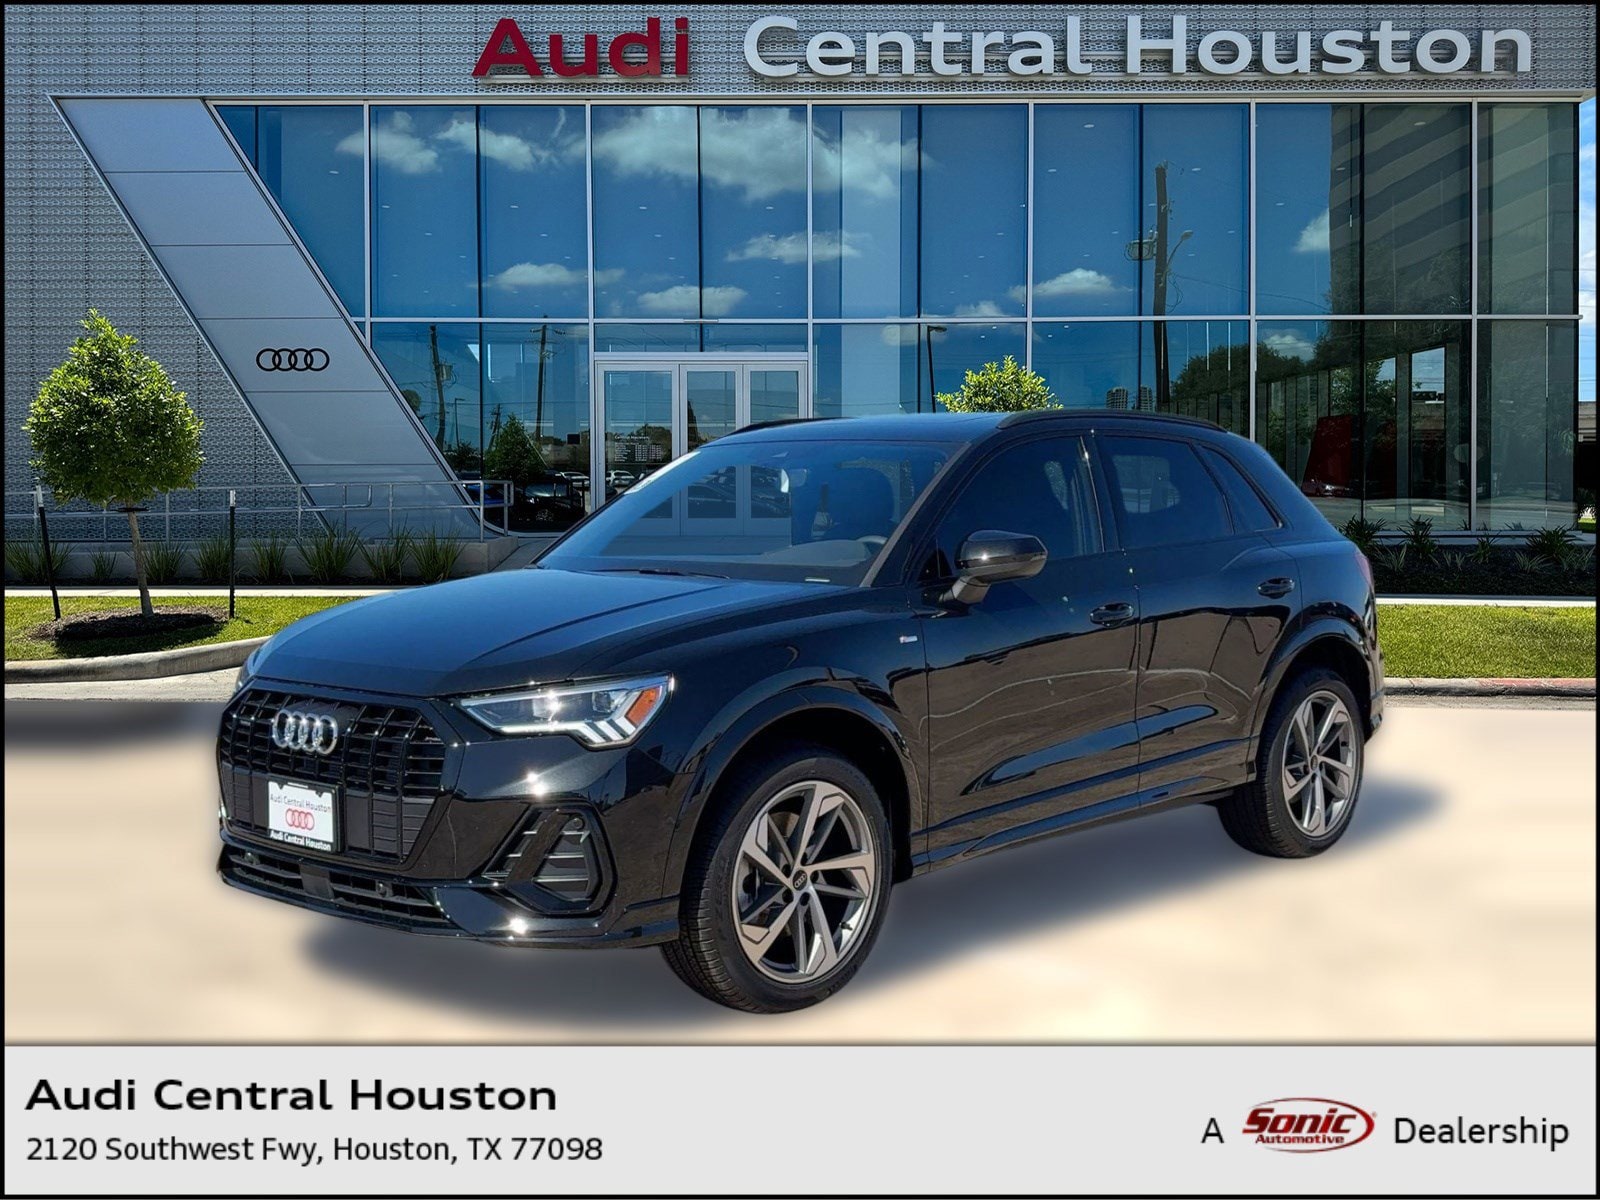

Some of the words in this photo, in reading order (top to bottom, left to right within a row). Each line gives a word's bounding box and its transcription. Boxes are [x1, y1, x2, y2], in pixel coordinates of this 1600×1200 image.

[471, 16, 690, 78] Audi
[743, 16, 1092, 77] Central
[1126, 15, 1532, 75] Houston
[270, 794, 282, 803] Audi
[284, 796, 304, 807] Central
[306, 800, 331, 812] Houston
[270, 830, 283, 840] Audi
[284, 833, 305, 846] Central
[306, 838, 331, 851] Houston
